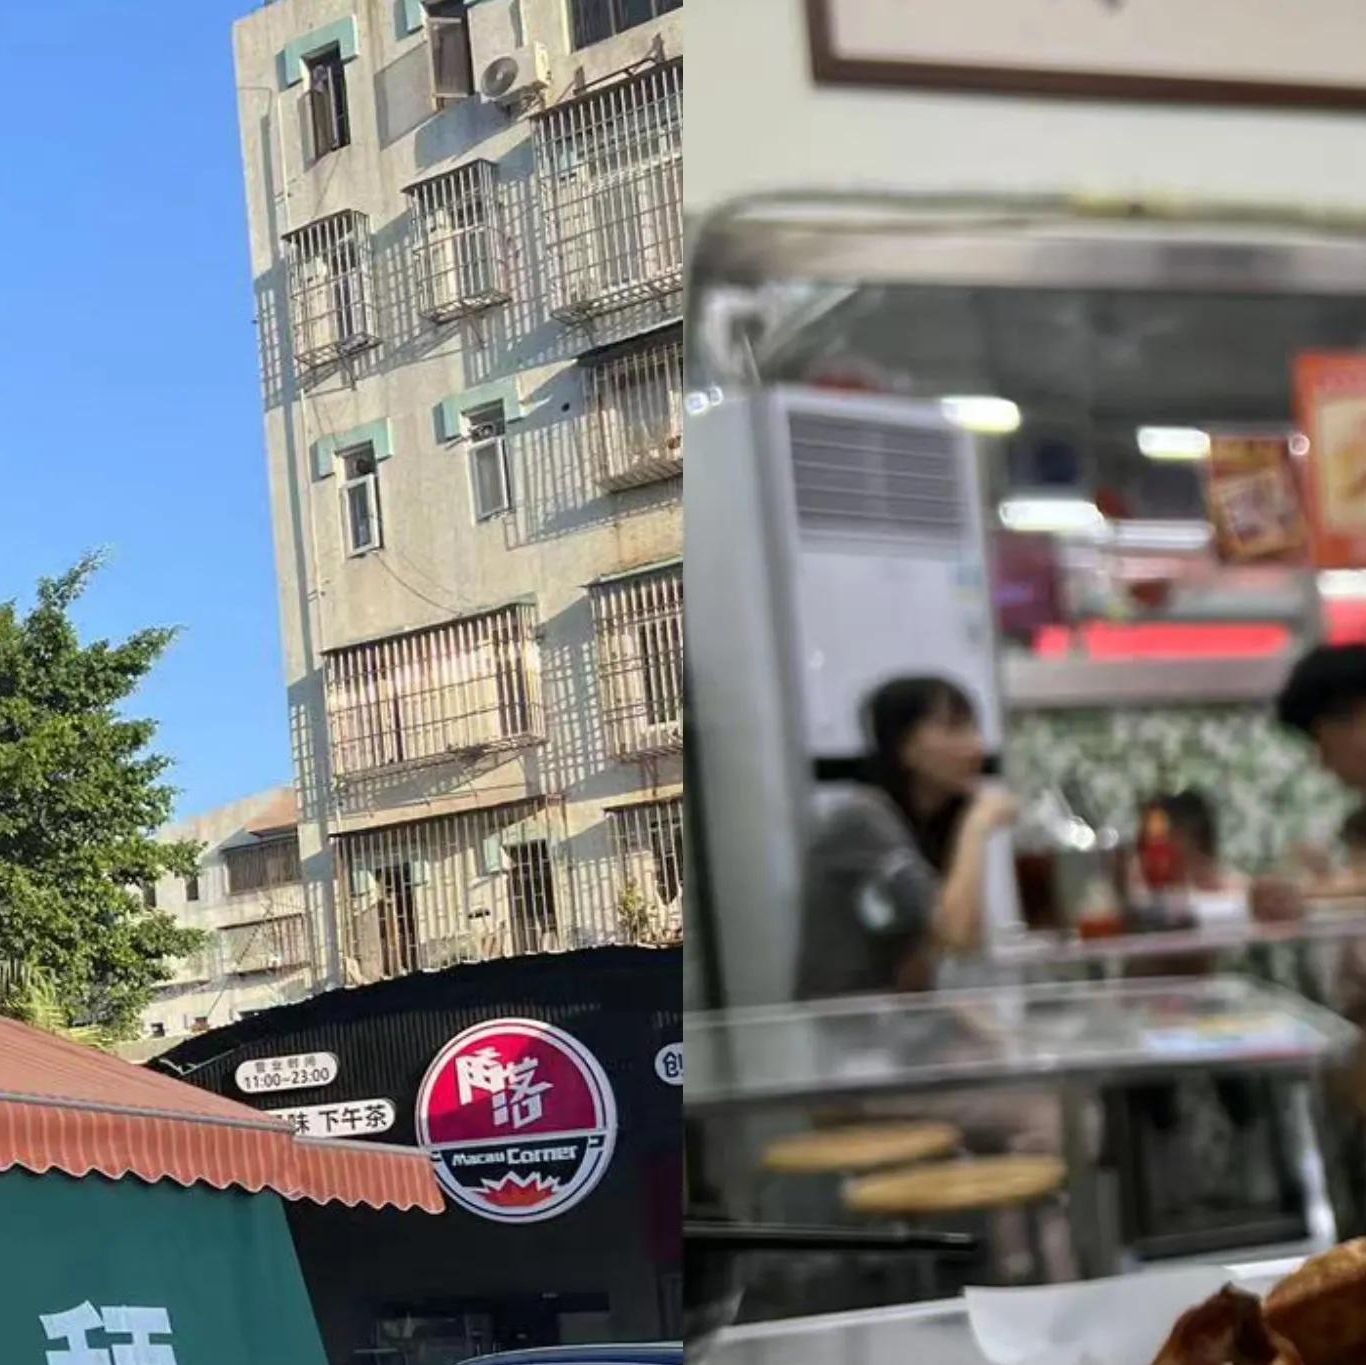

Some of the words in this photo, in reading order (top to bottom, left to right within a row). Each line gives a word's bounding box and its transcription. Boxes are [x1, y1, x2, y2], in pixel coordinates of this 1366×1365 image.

[319, 1105, 388, 1133] 下午茶
[451, 1149, 505, 1167] Macau
[506, 1143, 579, 1165] Corner
